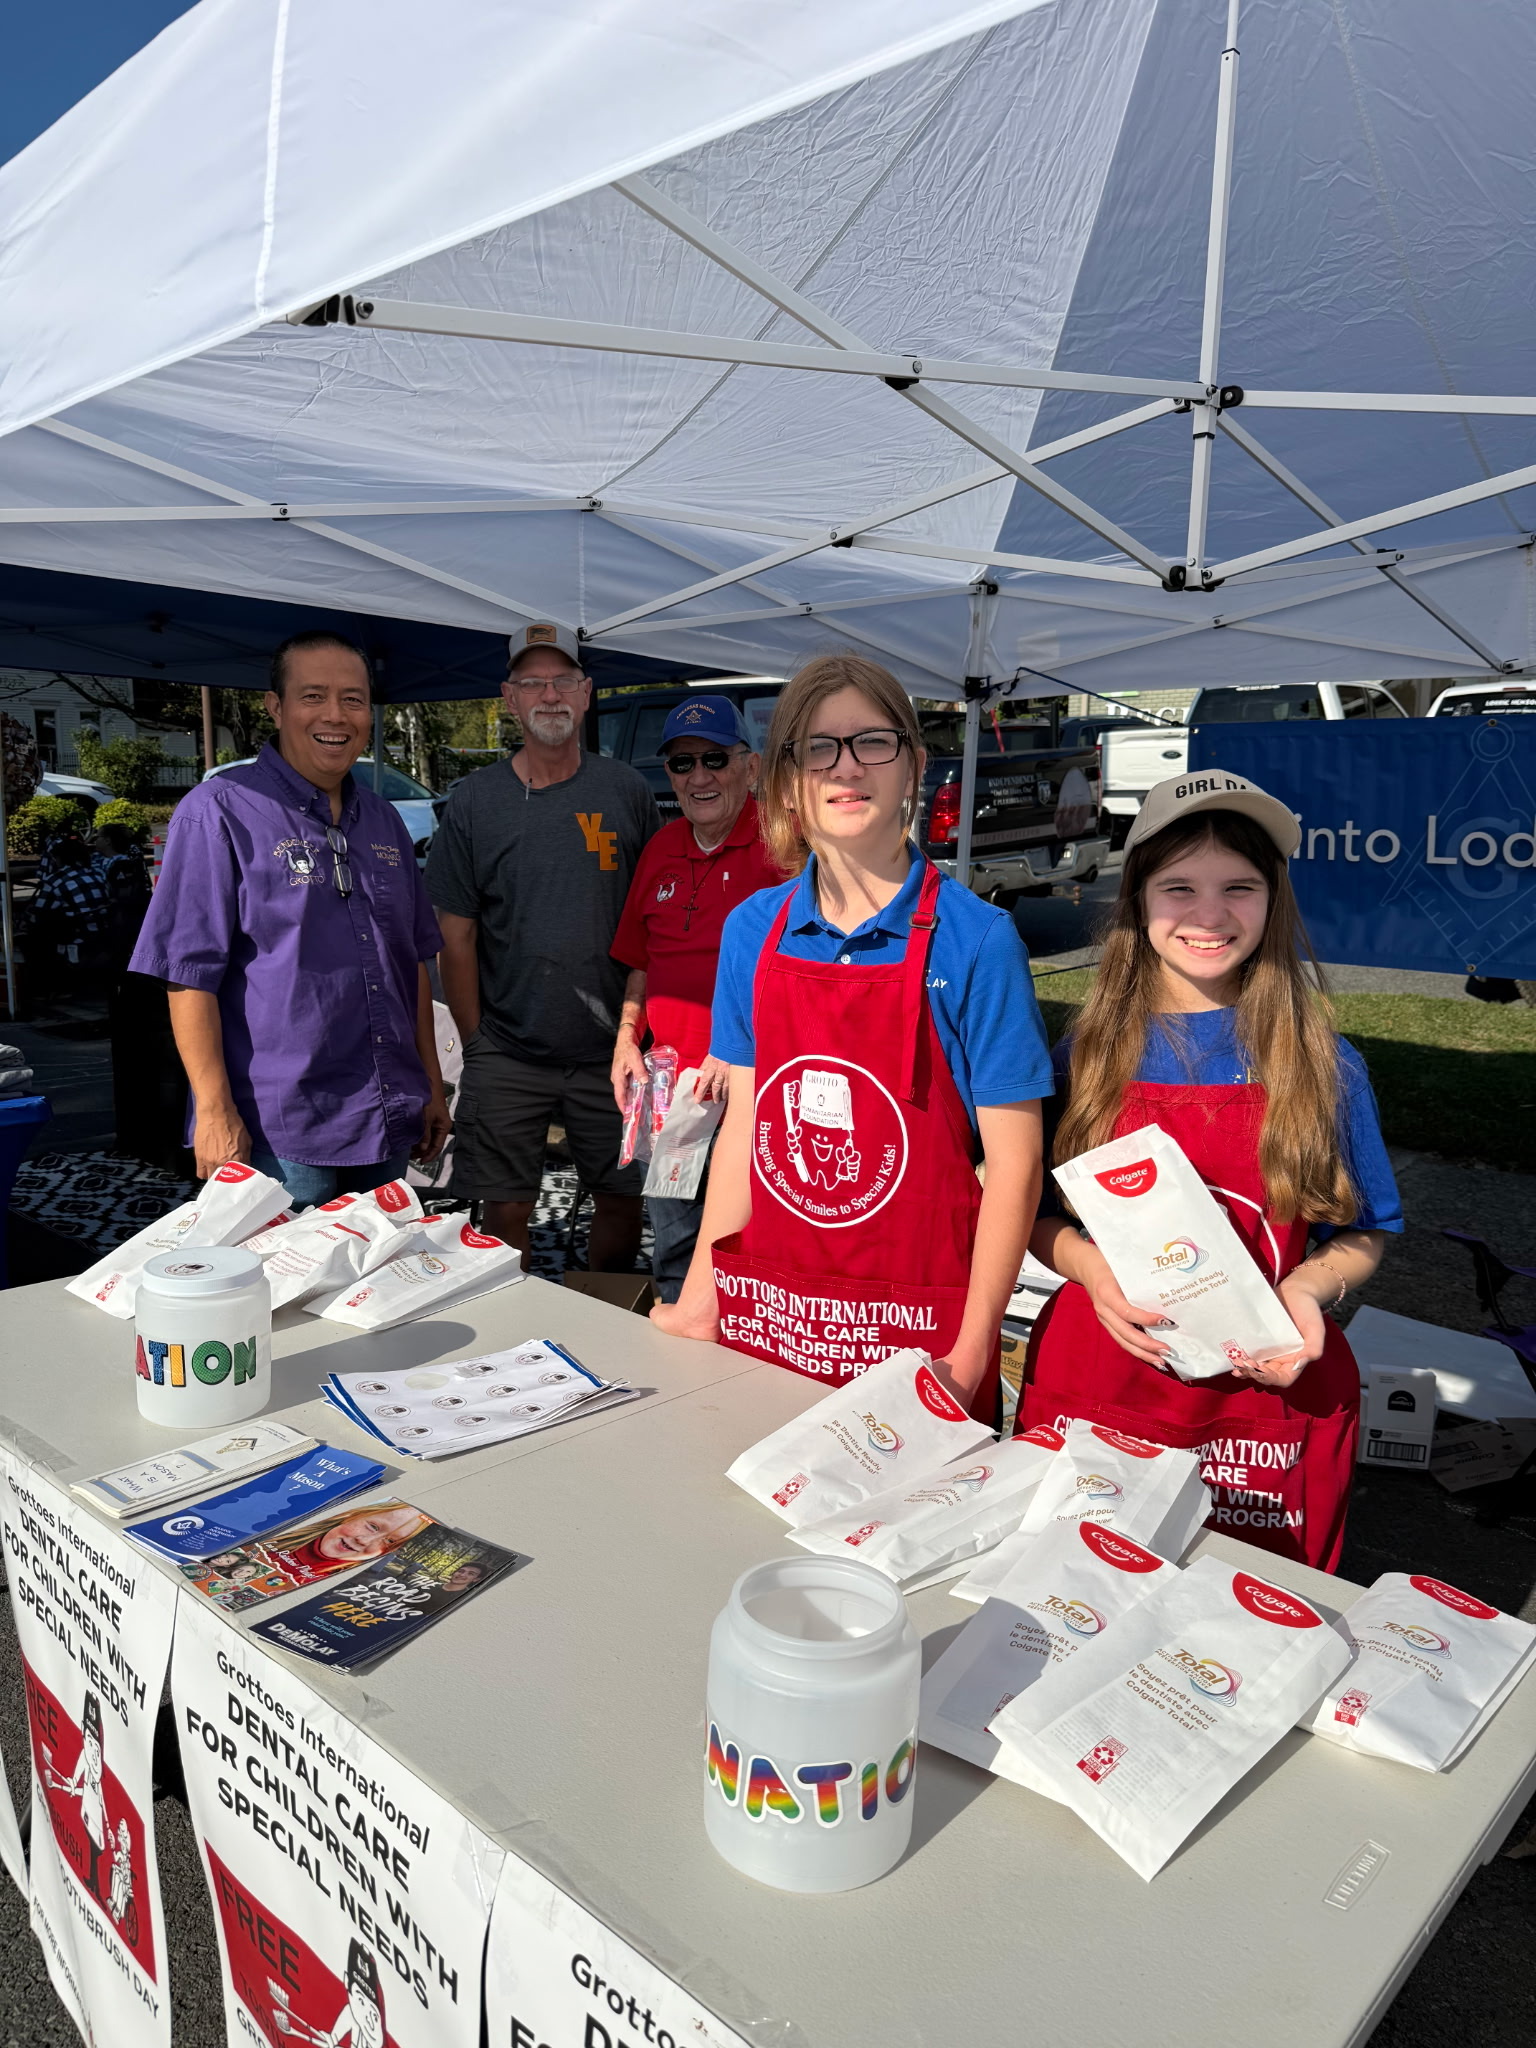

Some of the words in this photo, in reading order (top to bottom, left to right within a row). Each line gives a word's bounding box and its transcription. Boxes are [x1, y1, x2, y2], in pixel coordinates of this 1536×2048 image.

[1175, 777, 1221, 799] GIRL
[805, 1073, 839, 1088] GROTTO
[801, 1104, 844, 1118] HUMANITARIAN
[803, 1113, 839, 1126] FOUNDATION
[759, 1120, 776, 1173] Bringing
[773, 1170, 805, 1206] Special
[804, 1199, 838, 1216] Smiles
[840, 1204, 851, 1215] to
[850, 1176, 888, 1211] Special
[878, 1144, 896, 1178] Kids!
[1109, 1167, 1149, 1185] Colgate
[419, 1249, 442, 1271] Total
[1153, 1248, 1188, 1268] Total
[1159, 1291, 1172, 1300] Be
[1171, 1280, 1199, 1297] Dentist
[1198, 1269, 1224, 1287] Ready
[1161, 1298, 1179, 1308] with
[1179, 1287, 1210, 1305] Colgate
[755, 1303, 818, 1338] DENTAL
[823, 1325, 880, 1343] CARE
[788, 1292, 938, 1331] INTERNATIONAL
[727, 1314, 764, 1333] FOR
[768, 1323, 855, 1361] CHILDREN
[778, 1345, 834, 1375] NEEDS
[923, 1378, 954, 1415] Colgate
[822, 1423, 838, 1436] with
[837, 1433, 860, 1461] Colgate
[862, 1411, 894, 1444] Total
[832, 1419, 840, 1427] Be
[839, 1426, 863, 1452] Dentist
[861, 1449, 882, 1472] Ready
[147, 1475, 160, 1484] IS
[150, 1462, 182, 1483] MASON
[288, 1471, 326, 1492] Mason
[314, 1470, 325, 1478] A
[316, 1457, 352, 1476] What's
[1199, 1467, 1248, 1486] ARE
[116, 1476, 144, 1494] WHAT
[1227, 1489, 1282, 1509] WITH
[1079, 1509, 1096, 1521] prêt
[8, 1475, 55, 1528] Grottoes
[57, 1515, 136, 1600] International
[1091, 1531, 1145, 1564] Colgate
[19, 1506, 76, 1585] DENTAL
[78, 1568, 123, 1635] CARE
[278, 1549, 300, 1568] Rainbow
[368, 1576, 432, 1604] ROAD
[407, 1572, 443, 1591] THE
[1423, 1581, 1480, 1611] Colgate
[4, 1520, 29, 1569] FOR
[32, 1553, 103, 1655] CHILDREN
[106, 1635, 147, 1711] WITH
[319, 1601, 388, 1629] HERE
[333, 1584, 424, 1622] BEGINS
[1044, 1595, 1095, 1626] Total
[1244, 1585, 1302, 1618] Colgate
[1009, 1631, 1020, 1639] le
[1020, 1634, 1065, 1655] dentiste
[1014, 1622, 1046, 1636] Soyez
[1047, 1630, 1071, 1647] prêt
[1384, 1621, 1436, 1645] Total
[18, 1575, 77, 1662] SPECIAL
[80, 1644, 129, 1728] NEEDS
[1009, 1640, 1049, 1657] Colgate
[1366, 1639, 1407, 1657] Dentist
[1409, 1654, 1443, 1676] Ready
[1368, 1644, 1411, 1666] Colgate
[1173, 1648, 1227, 1685] Total
[1176, 1659, 1214, 1687] PREVENTION
[1126, 1680, 1166, 1710] Colgate
[1136, 1662, 1168, 1687] Soyez
[1168, 1686, 1191, 1705] prêt
[1190, 1704, 1218, 1724] pour
[1188, 1675, 1210, 1689] ACTIVE
[1128, 1669, 1139, 1679] le
[1140, 1677, 1184, 1711] dentiste
[1183, 1709, 1210, 1730] avec
[216, 1649, 295, 1731] Grottoes
[300, 1716, 431, 1855] International
[227, 1690, 329, 1807] DENTAL
[335, 1792, 412, 1895] CARE
[186, 1706, 239, 1771] FOR
[245, 1754, 378, 1907] CHILDREN
[384, 1887, 459, 2006] WITH
[217, 1775, 332, 1899] SPECIAL
[338, 1881, 430, 2011] NEEDS
[33, 1894, 46, 1924] FOR
[44, 1920, 58, 1955] MORE
[219, 1867, 302, 1994] FREE
[132, 1971, 160, 2020] DAY
[353, 1971, 376, 1999] GROTTO
